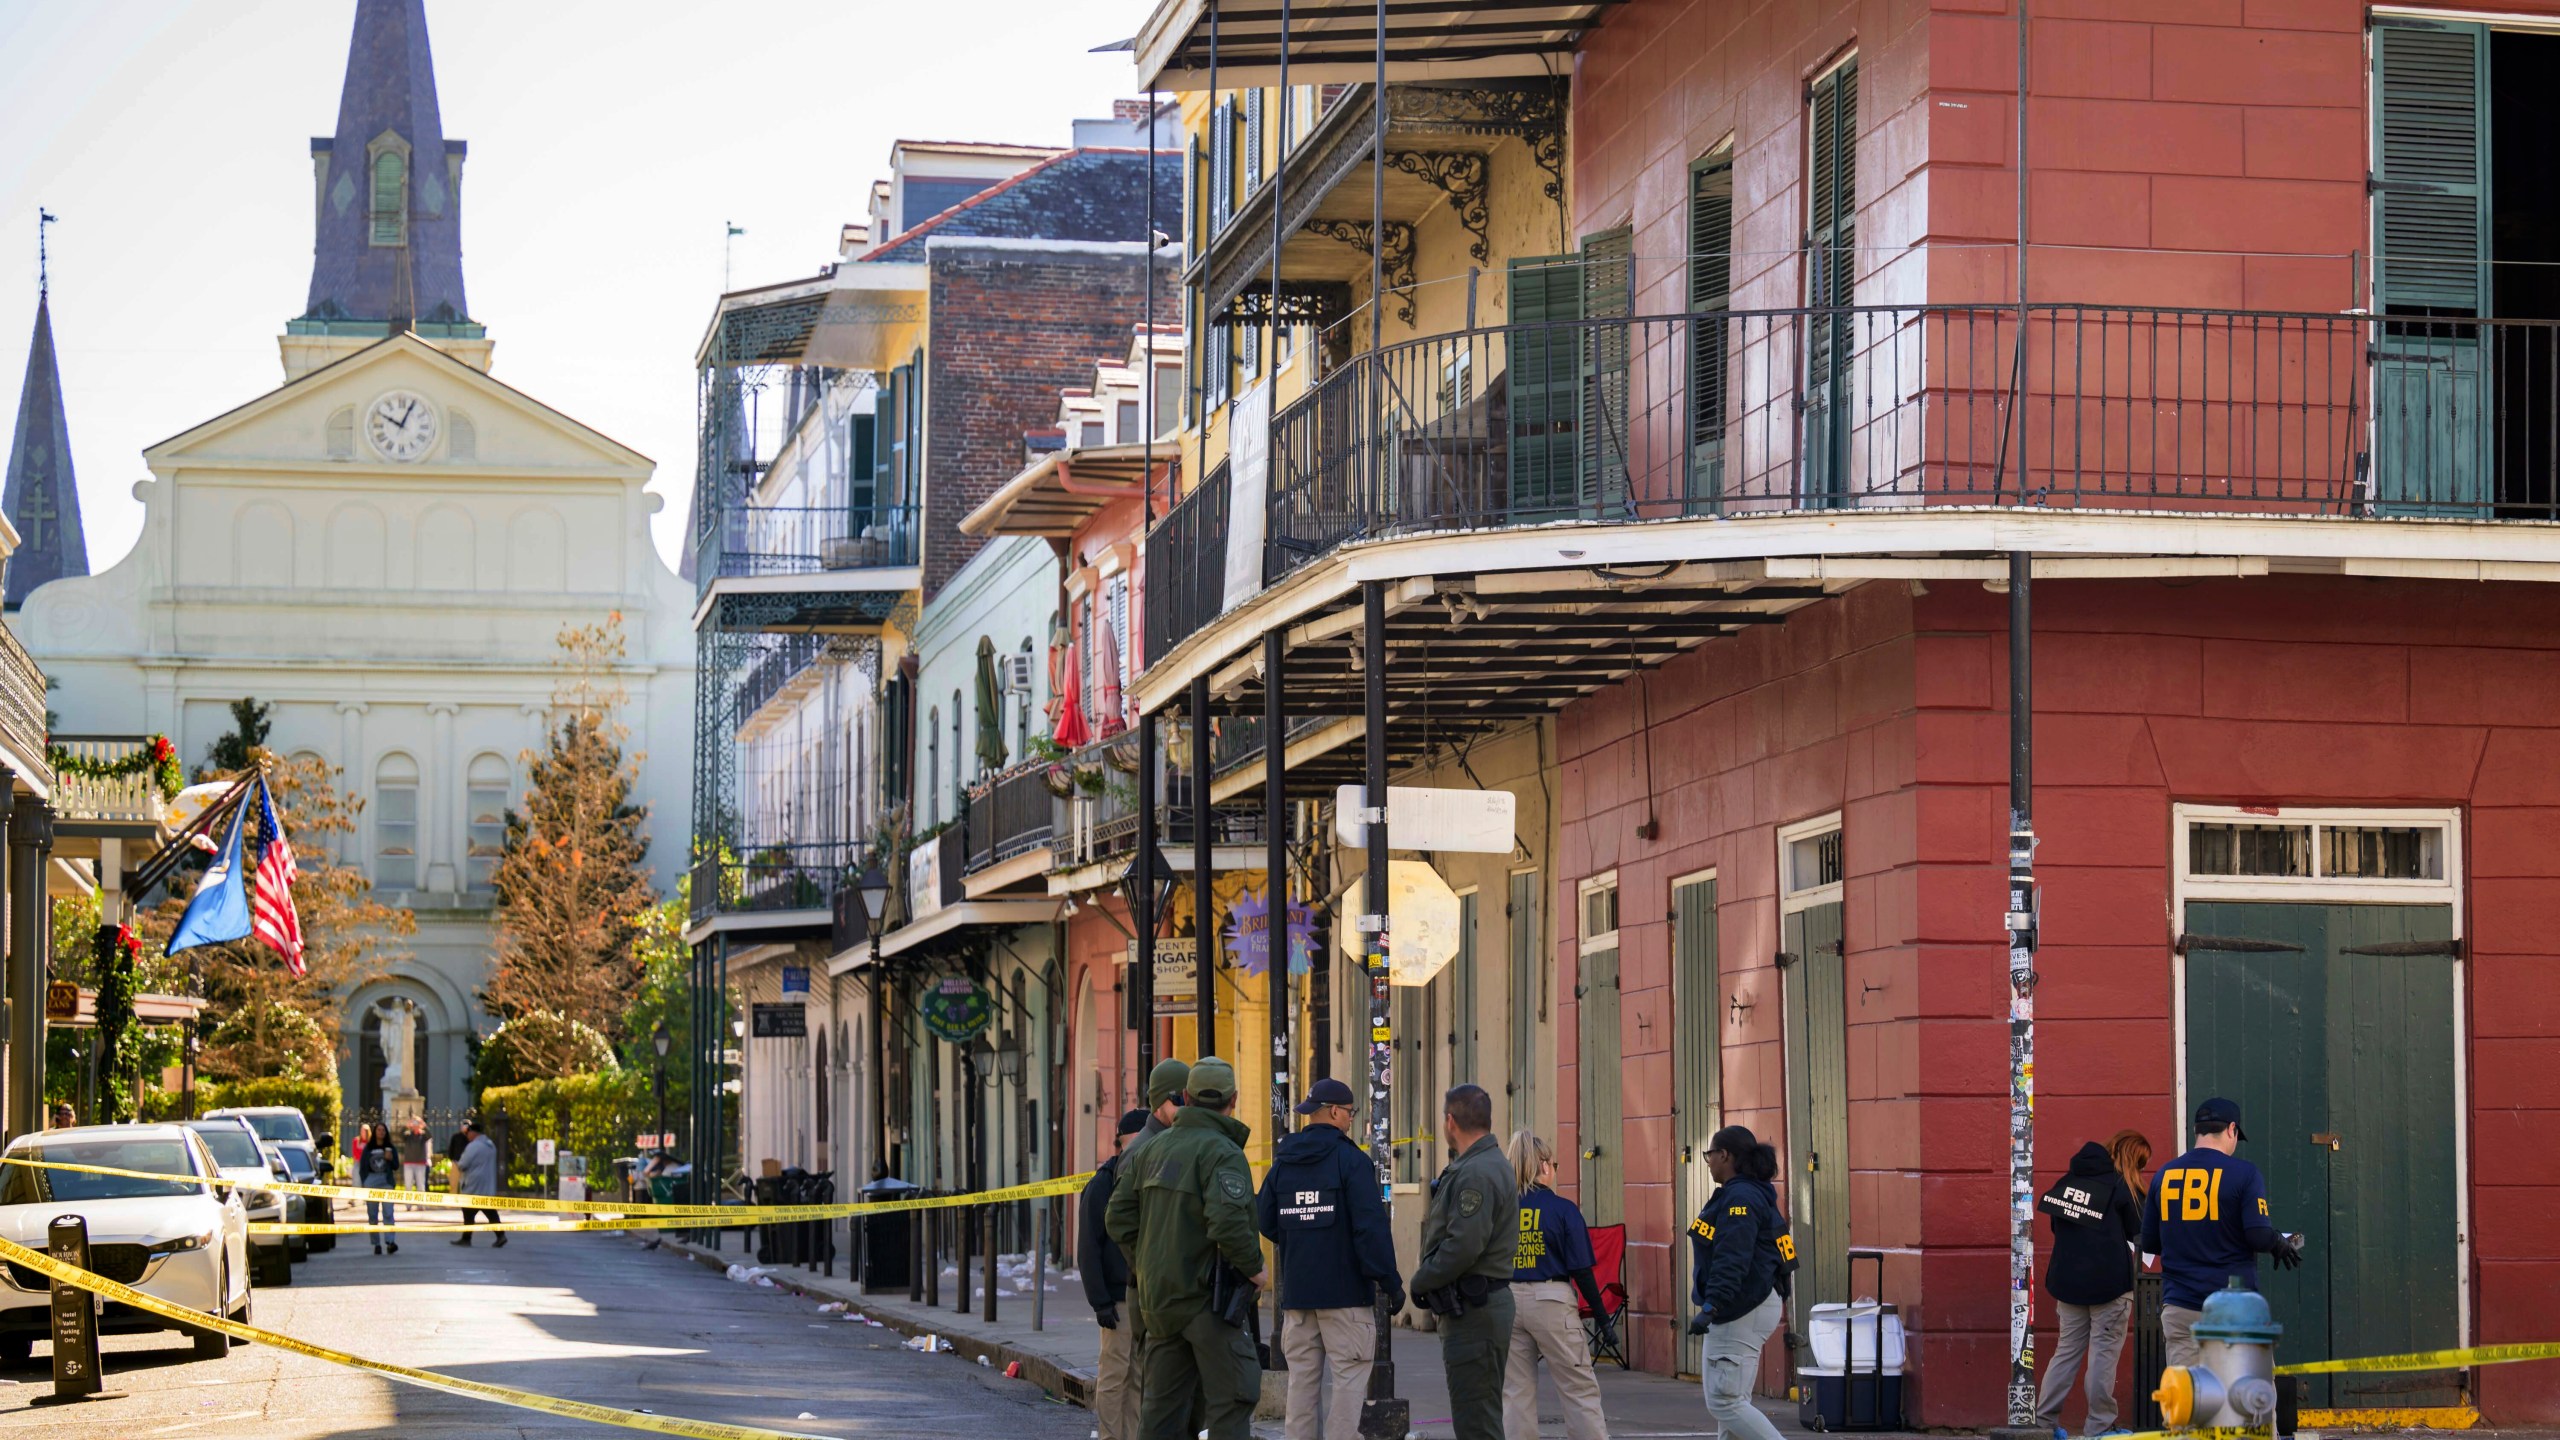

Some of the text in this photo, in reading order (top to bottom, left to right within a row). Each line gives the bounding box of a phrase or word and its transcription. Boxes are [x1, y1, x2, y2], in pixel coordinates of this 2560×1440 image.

[1153, 952, 1197, 964] IGAR
[1156, 965, 1188, 974] SHOP
[1295, 1191, 1319, 1205] FBI
[2062, 1186, 2091, 1206] FBI
[2160, 1168, 2223, 1222] FBI
[1280, 1205, 1334, 1215] EVIDENCE RESPONSE
[1729, 1206, 1747, 1216] FBI
[2043, 1195, 2104, 1220] EVIDENCE RESPONSE
[2063, 1208, 2080, 1219] TEAM
[1519, 1208, 1541, 1231] BI
[1691, 1218, 1716, 1241] FBI
[1518, 1231, 1543, 1244] ENCE
[1516, 1243, 1546, 1256] PONSE
[1776, 1234, 1796, 1263] FB
[1512, 1255, 1536, 1269] TEAM
[60, 1328, 80, 1336] Parking
